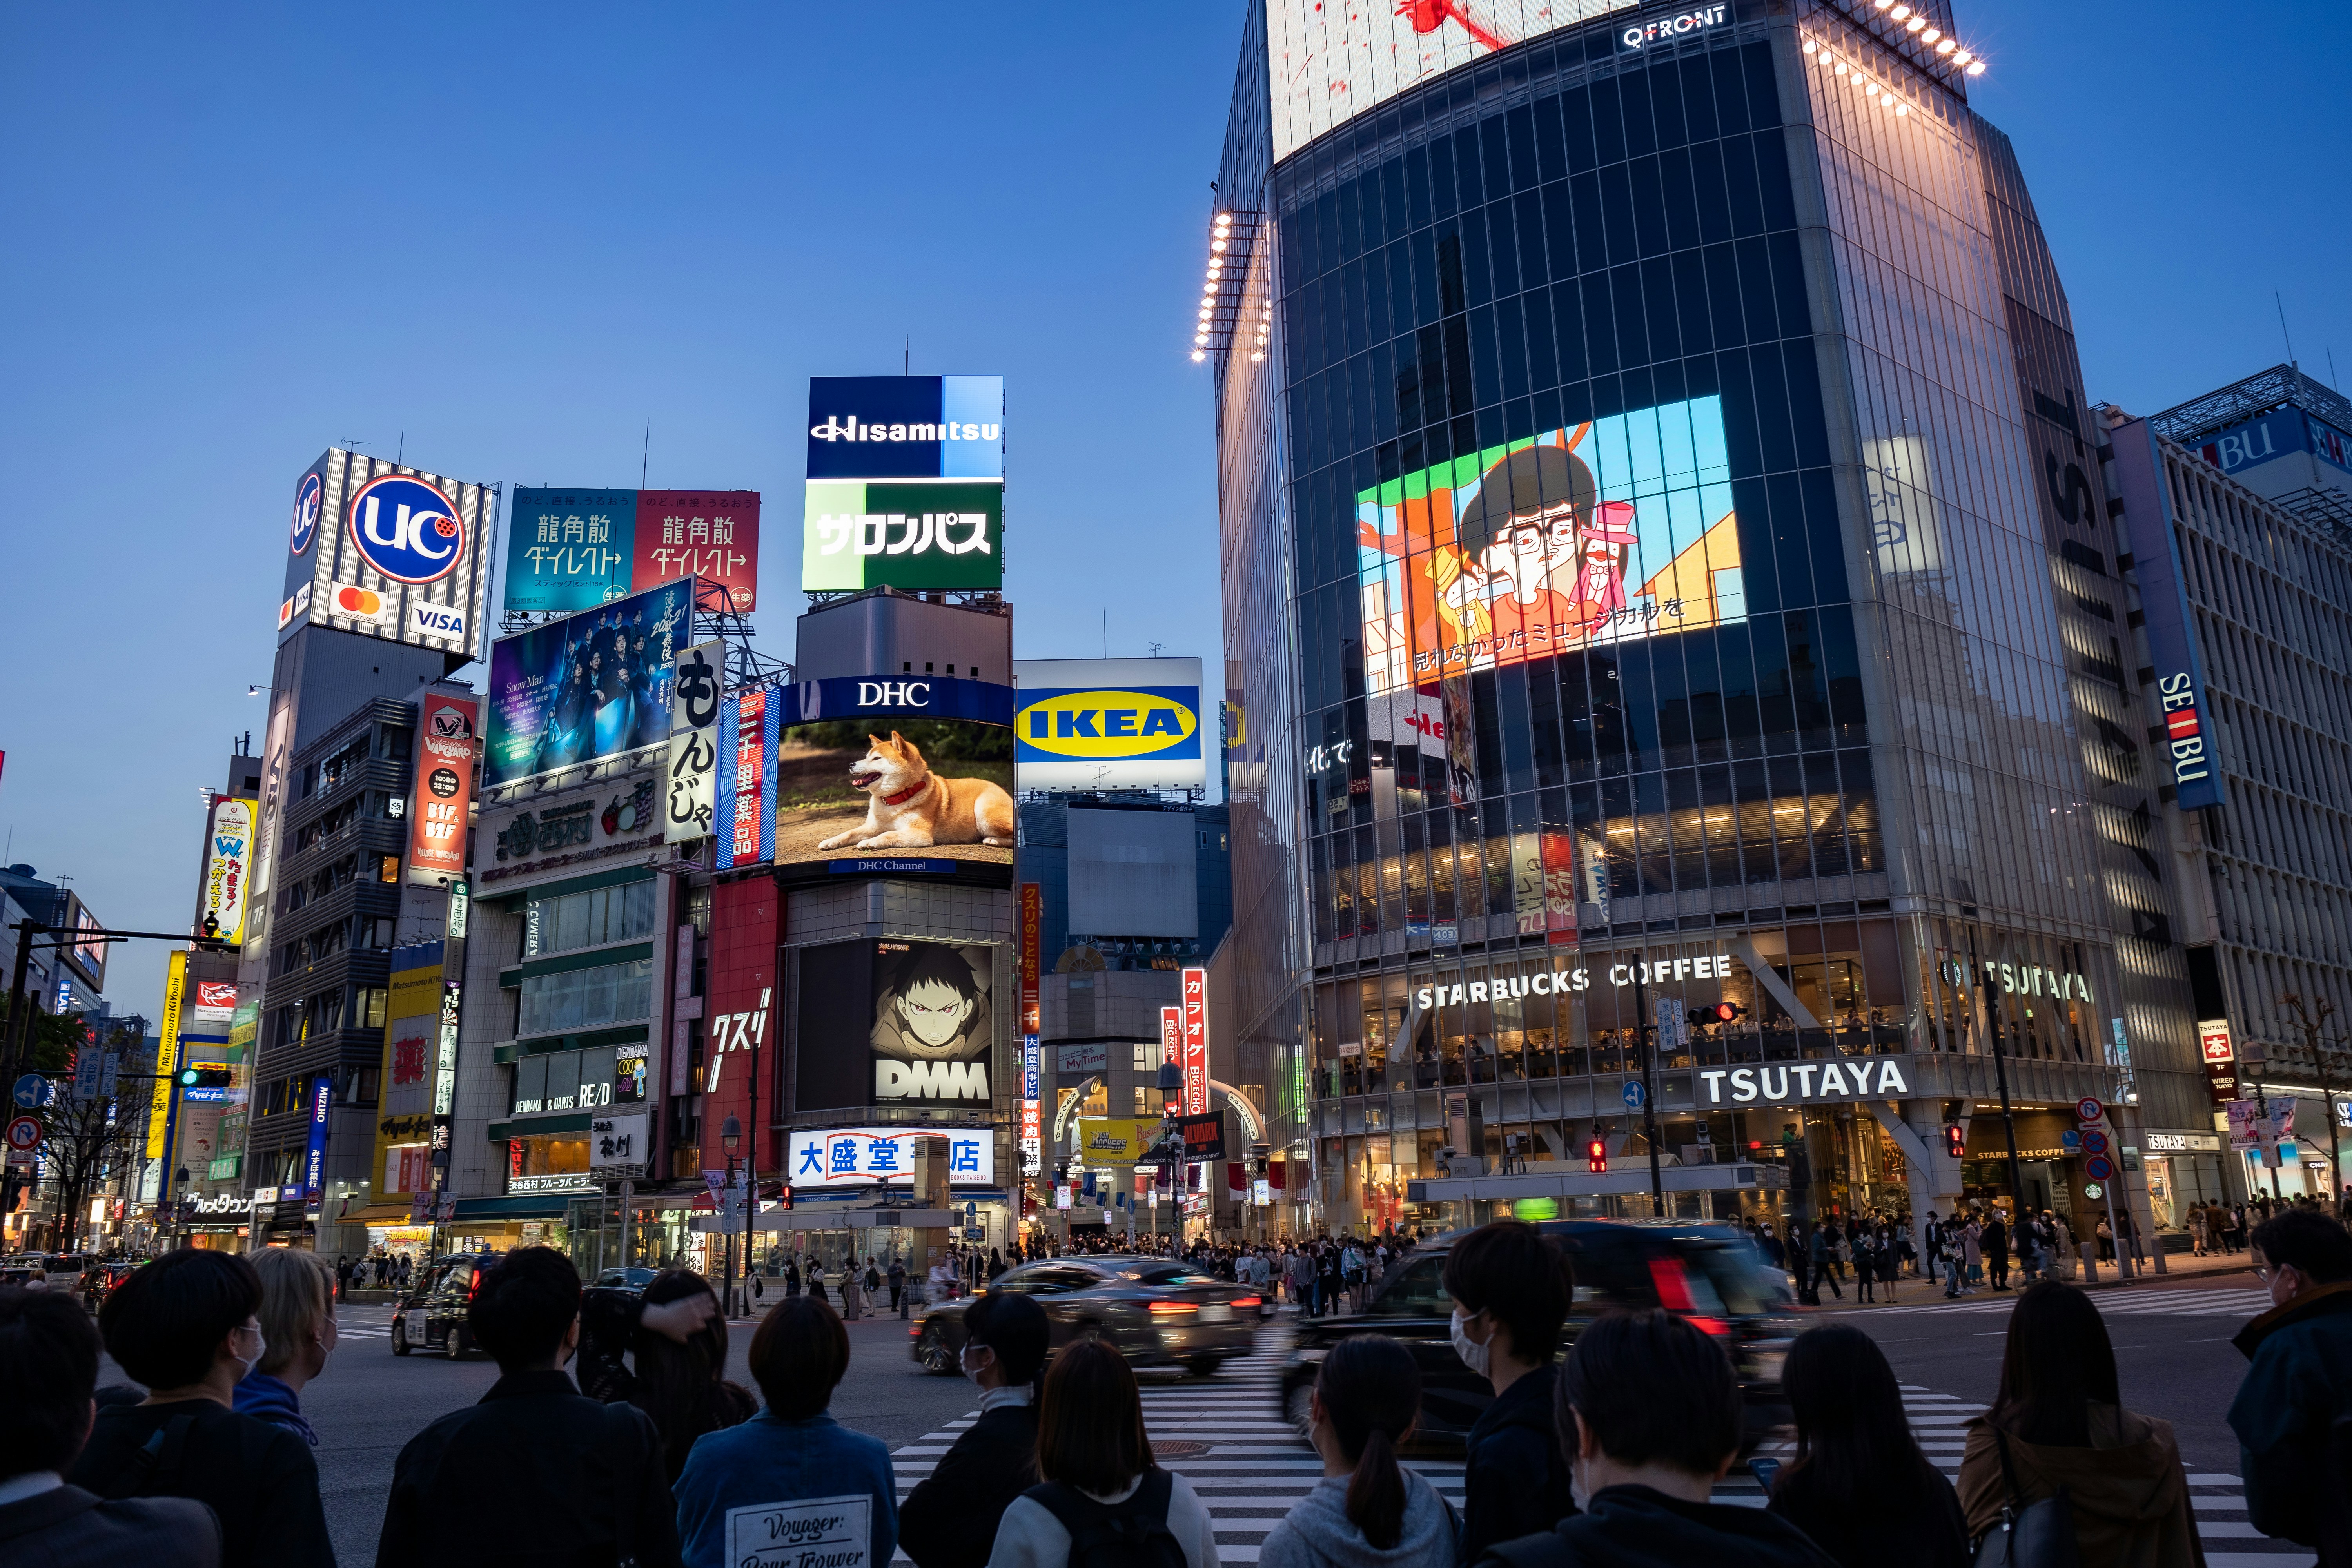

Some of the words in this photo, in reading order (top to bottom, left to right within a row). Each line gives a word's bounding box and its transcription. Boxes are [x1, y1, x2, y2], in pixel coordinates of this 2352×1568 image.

[1624, 5, 1725, 49] QFRONT
[811, 416, 999, 441] Hisamitsu
[522, 496, 629, 506] のど、直接、うるおう
[646, 497, 753, 508] のど、直接、うるおう
[537, 514, 610, 544] 龍角散
[663, 516, 735, 546] 龍角散
[817, 512, 991, 555] サロンパス
[524, 546, 621, 575] ダイレクト
[650, 548, 746, 577] ダイレクト
[534, 579, 572, 588] スティック
[297, 590, 309, 607] VISA
[731, 593, 751, 602] 生薬
[339, 610, 377, 623] mastercard
[414, 608, 463, 633] VISA
[660, 661, 674, 670] ZERO
[506, 681, 526, 694] Snow
[527, 675, 544, 688] Man
[858, 682, 929, 706] DHC
[1030, 708, 1185, 739] IKEA
[2159, 673, 2208, 785] SEIBU
[670, 650, 719, 833] もんじゃ
[434, 782, 455, 791] 23:00
[435, 775, 456, 784] 10:00
[733, 700, 758, 856] 三千里薬品
[428, 802, 457, 820] B1F
[425, 820, 457, 839] B2F
[858, 861, 882, 871] DHC
[884, 860, 926, 870] Channel
[253, 906, 264, 925] 7F
[454, 897, 463, 928] 渋谷西村
[1025, 889, 1036, 981] クスリのことなら
[1609, 955, 1732, 986] COFFEE
[392, 978, 426, 990] Matsumoto
[1418, 968, 1590, 1010] STARBUCKS
[452, 988, 460, 1008] ダーツ
[1023, 990, 1039, 1026] 三千
[160, 1012, 176, 1066] Matsumoto
[168, 977, 180, 1011] KiYoshi
[1166, 1019, 1174, 1036] BIG
[1187, 980, 1203, 1057] カラオケ
[1662, 1003, 1673, 1046] 渋谷駅前
[1675, 1002, 1685, 1042] スクランブル式
[617, 1045, 648, 1059] DENDAMA
[1059, 1047, 1094, 1061] コンビニ脱毛
[2206, 1037, 2228, 1056] 本
[84, 1053, 98, 1094] 渋谷駅前
[394, 1037, 427, 1084] 薬
[1027, 1038, 1037, 1096] 大盛堂商事ビル
[103, 1055, 116, 1094] スクランブル式
[876, 1060, 990, 1099] DMM
[1190, 1066, 1200, 1085] BIG
[1700, 1060, 1908, 1103] TSUTAYA
[317, 1087, 328, 1122] MIZUHO
[516, 1099, 541, 1113] DENDAMA
[548, 1099, 553, 1110] &
[554, 1096, 573, 1109] DARTS
[1191, 1086, 1201, 1114] ECHO
[1055, 1093, 1076, 1139] 渋谷センター街
[1229, 1094, 1256, 1138] 渋谷センター街
[436, 1125, 448, 1149] HUB
[1087, 1132, 1127, 1150] ROCKERS
[1184, 1122, 1218, 1144] ALVARK
[2148, 1136, 2186, 1149] TSUTAYA
[799, 1138, 979, 1175] 大盛堂店
[1978, 1149, 2034, 1160] STARBCKS
[309, 1150, 320, 1188] みずほ銀行
[511, 1180, 538, 1189] 渋谷西村
[186, 1191, 252, 1213] グルメタウン
[764, 1514, 844, 1543] Voyager:
